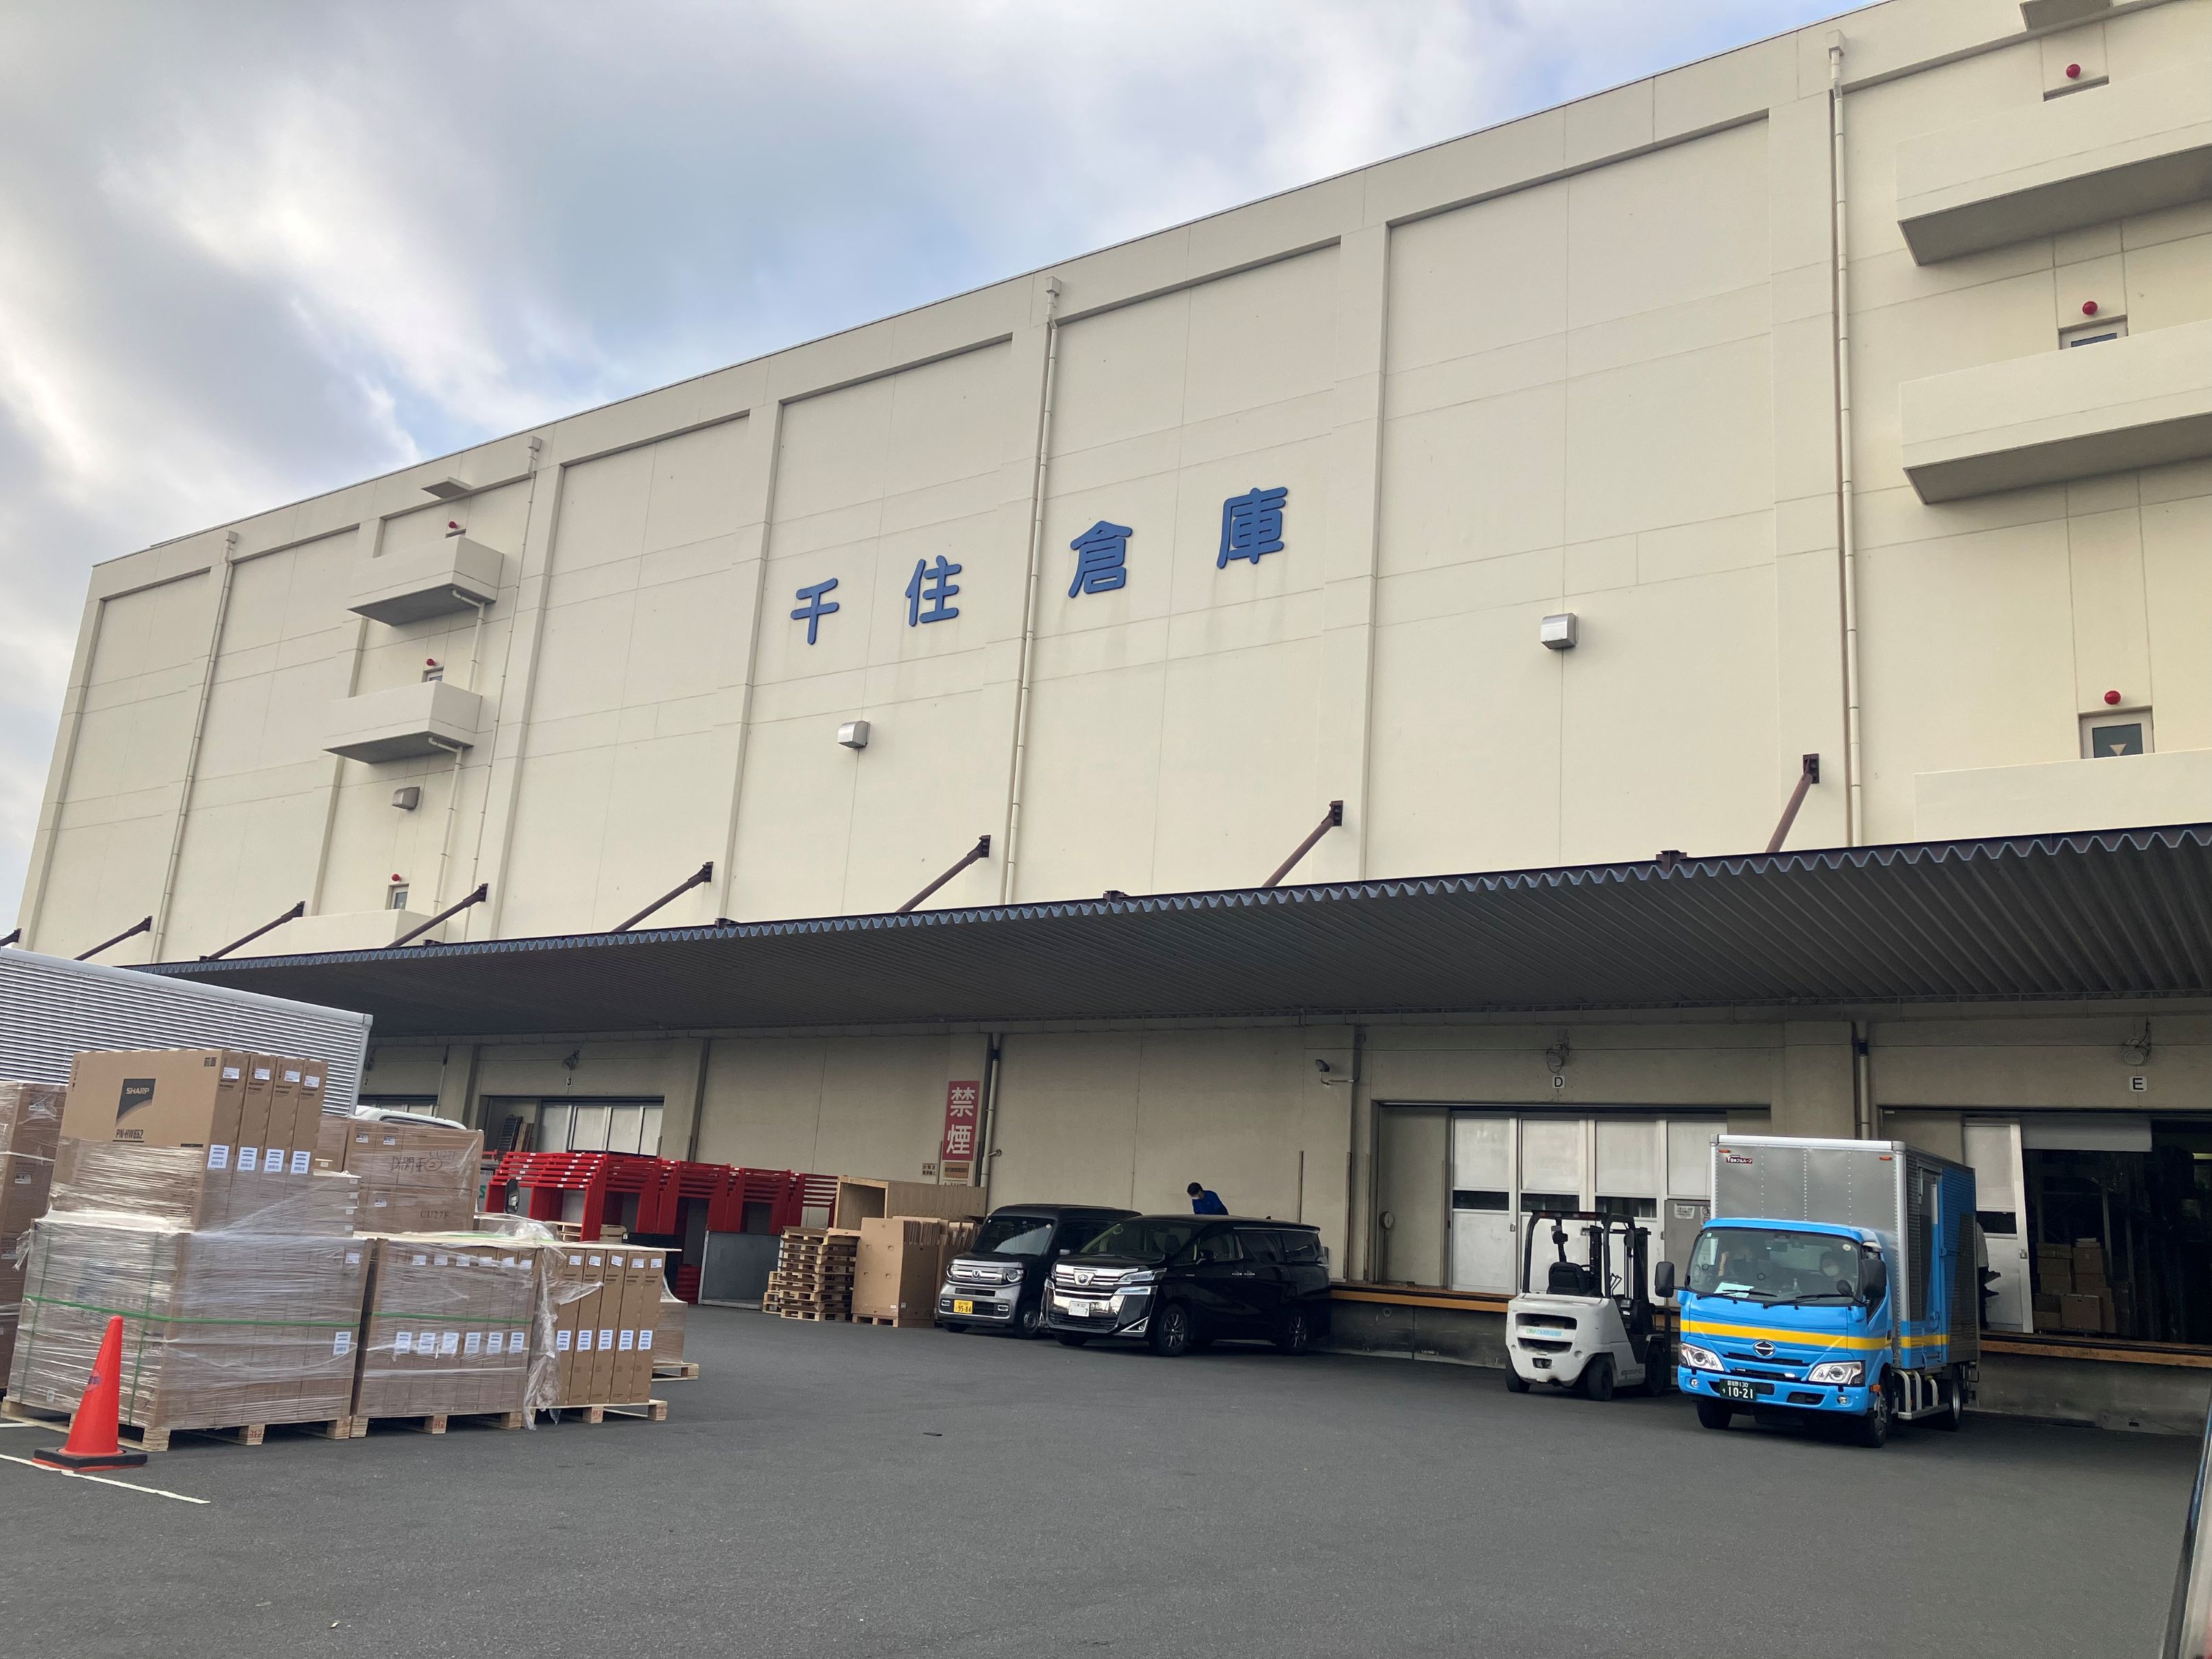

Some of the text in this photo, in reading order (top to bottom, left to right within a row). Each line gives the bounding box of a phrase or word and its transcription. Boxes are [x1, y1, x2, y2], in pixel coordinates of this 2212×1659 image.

[790, 487, 1288, 645] 千住倉庫
[1554, 1077, 1563, 1087] D
[2132, 1078, 2143, 1090] E
[946, 1087, 975, 1154] 禁煙
[116, 1129, 144, 1139] PN-HW652
[420, 1211, 450, 1219] CU27F
[1729, 1386, 1753, 1399] 10-21
